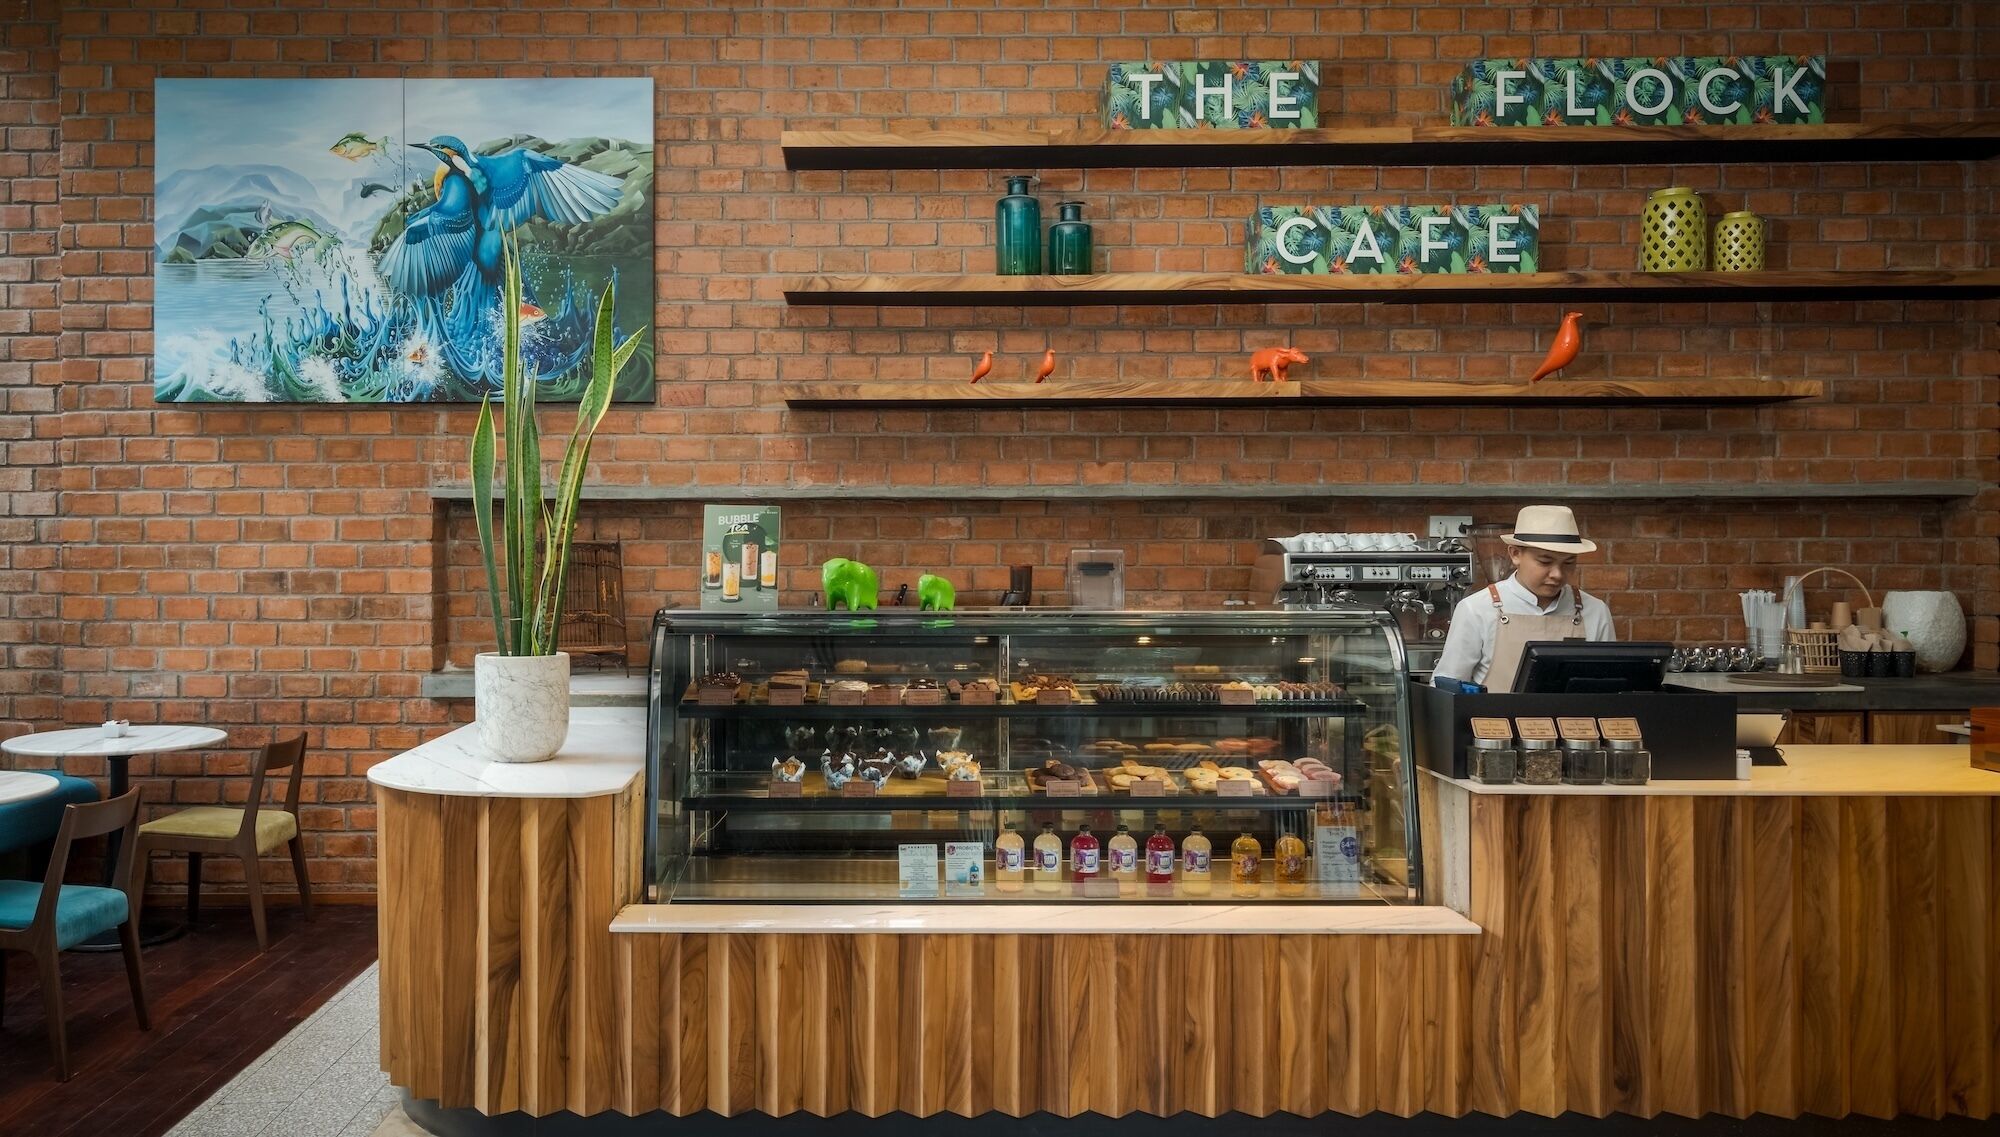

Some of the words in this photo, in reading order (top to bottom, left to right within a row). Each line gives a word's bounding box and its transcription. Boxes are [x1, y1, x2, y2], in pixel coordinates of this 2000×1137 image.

[1128, 71, 1301, 121] THE
[1494, 65, 1811, 118] FLOCK
[1275, 215, 1522, 265] CAFE
[718, 513, 760, 525] BUBBLE
[730, 523, 749, 535] Tea
